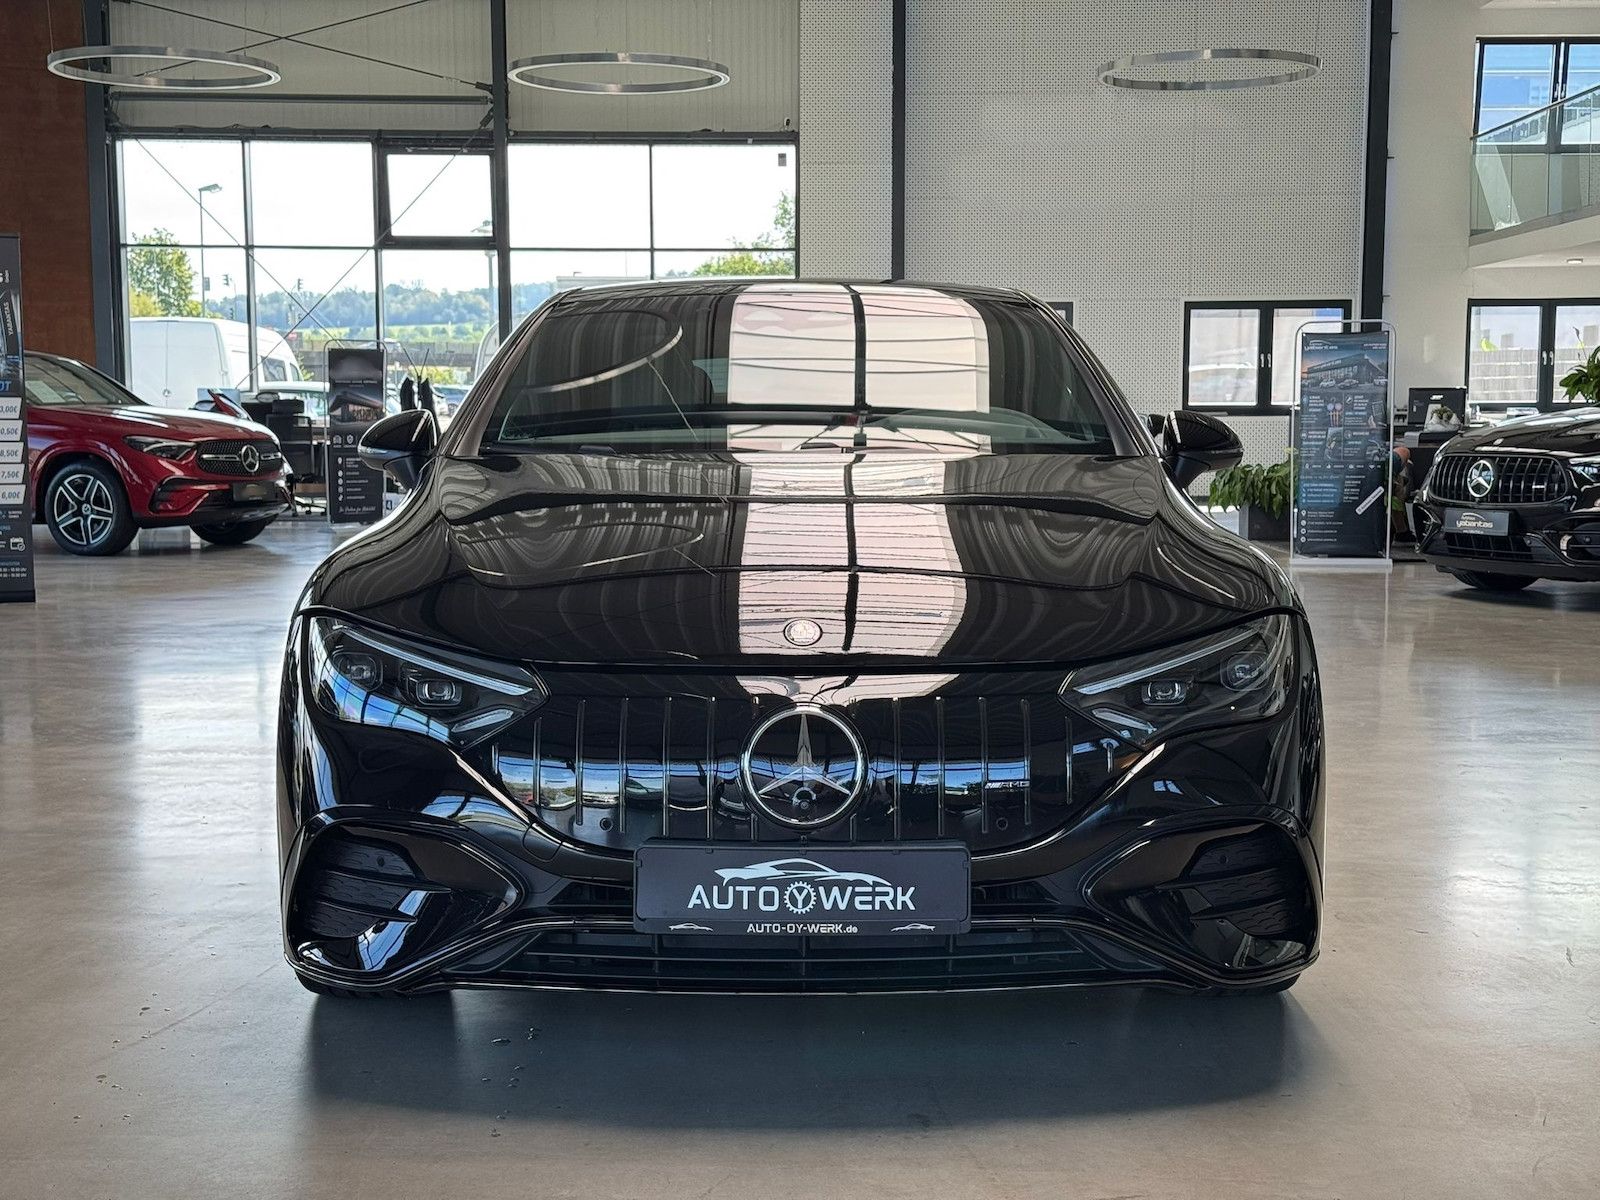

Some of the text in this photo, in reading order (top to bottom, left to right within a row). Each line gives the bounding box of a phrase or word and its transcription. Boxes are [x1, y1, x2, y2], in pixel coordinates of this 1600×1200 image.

[688, 884, 779, 911] AUTO
[815, 886, 916, 911] WERK
[747, 922, 858, 934] AUTO-OY-WERK.de
